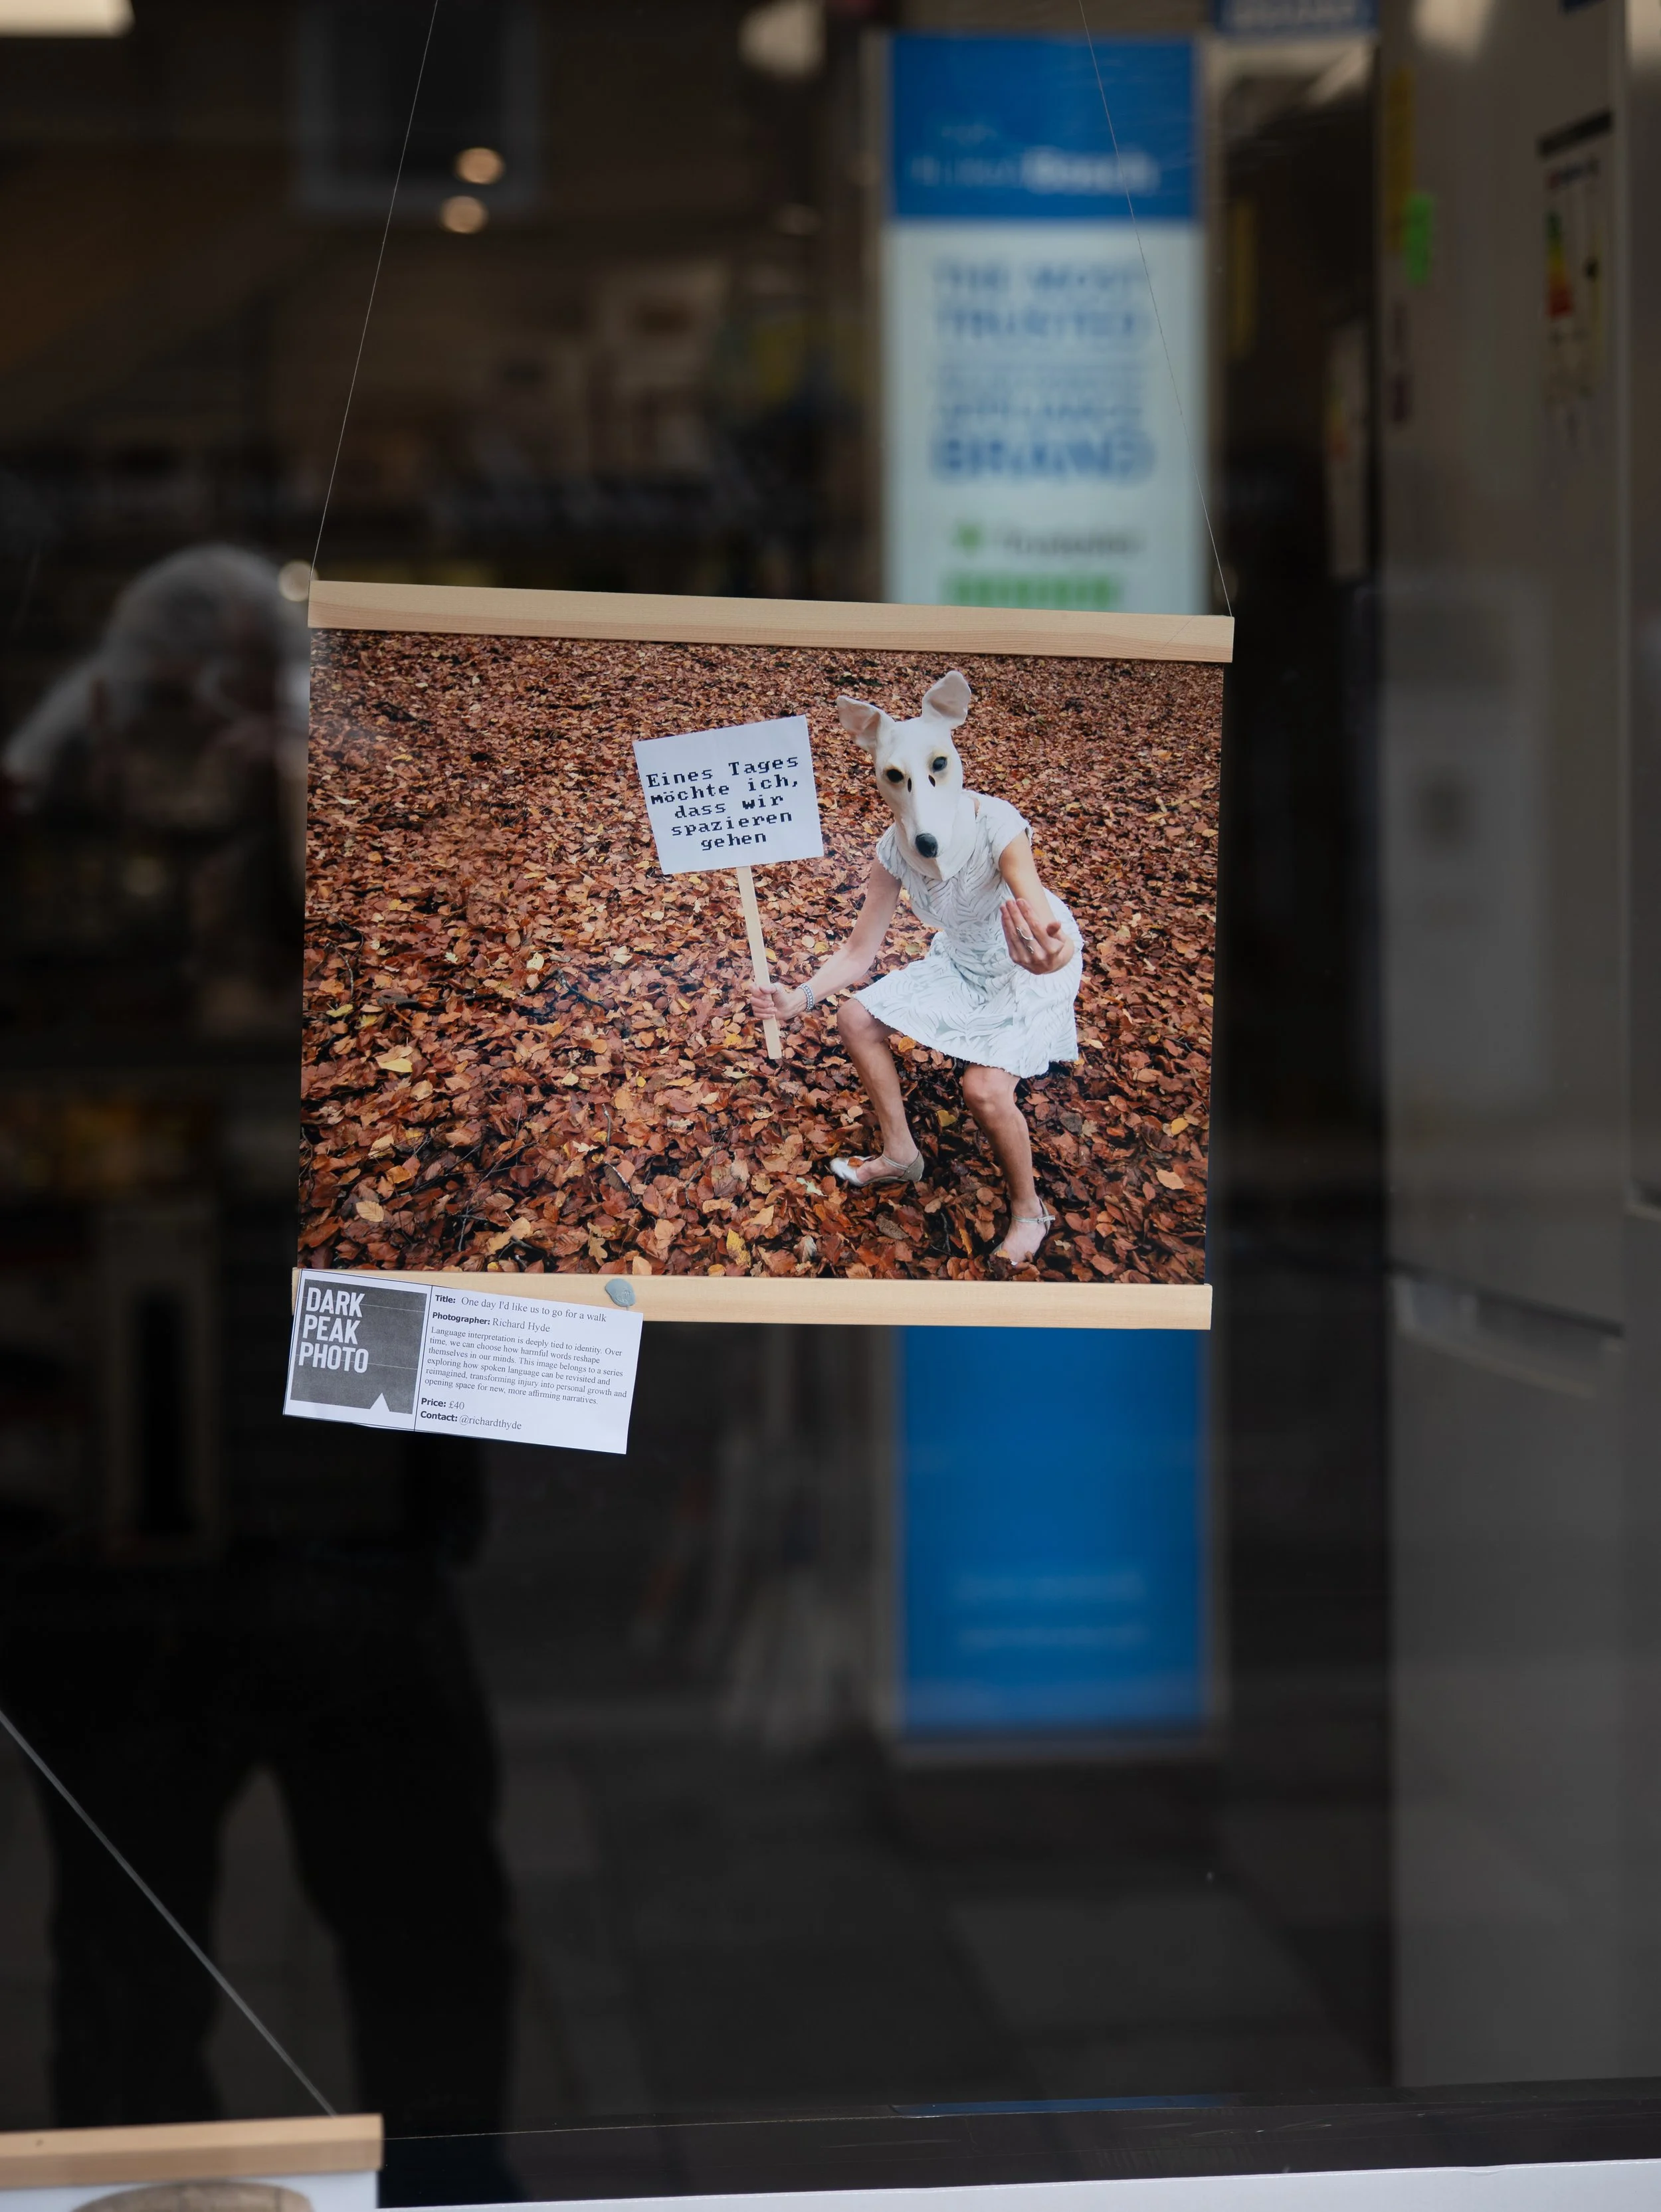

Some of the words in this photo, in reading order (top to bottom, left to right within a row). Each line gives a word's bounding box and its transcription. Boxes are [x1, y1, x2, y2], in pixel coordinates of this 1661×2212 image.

[646, 769, 713, 788] Eines
[728, 757, 799, 776] Tages
[650, 783, 730, 805] möchte
[747, 774, 798, 791] ich,
[674, 803, 726, 818] dass
[742, 794, 783, 810] wir
[671, 812, 792, 836] spazieren
[701, 833, 767, 851] gehen
[306, 1287, 365, 1317] DARK
[435, 1295, 456, 1303] Title:
[461, 1297, 479, 1307] One
[481, 1299, 496, 1310] day
[499, 1301, 510, 1310] I'd
[512, 1302, 528, 1312] like
[551, 1309, 563, 1318] go
[565, 1309, 578, 1318] for
[587, 1313, 607, 1322] walk
[302, 1314, 361, 1344] PEAK
[432, 1312, 490, 1325] Photographer:
[492, 1318, 525, 1329] Richard
[528, 1321, 551, 1333] Hyde
[430, 1336, 448, 1346] time,
[476, 1342, 502, 1352] choose
[504, 1344, 520, 1354] how
[521, 1346, 549, 1358] harmful
[550, 1352, 571, 1360] words
[573, 1354, 601, 1366] reshape
[431, 1326, 466, 1339] Language
[468, 1330, 516, 1344] interpretation
[518, 1336, 524, 1344] is
[526, 1337, 549, 1350] deeply
[551, 1340, 564, 1349] tied
[575, 1342, 602, 1356] identity.
[605, 1346, 623, 1356] Over
[298, 1341, 369, 1373] PHOTO
[427, 1357, 461, 1370] exploring
[463, 1360, 479, 1370] how
[480, 1364, 506, 1373] spoken
[508, 1365, 539, 1379] language
[555, 1371, 565, 1380] be
[565, 1374, 596, 1384] revisited
[597, 1377, 611, 1386] and
[429, 1346, 468, 1358] themselves
[470, 1350, 477, 1359] in
[492, 1354, 517, 1364] minds.
[519, 1356, 535, 1366] This
[536, 1358, 558, 1371] image
[559, 1362, 587, 1374] belongs
[603, 1368, 623, 1377] series
[425, 1378, 453, 1390] opening
[477, 1382, 488, 1392] for
[490, 1386, 506, 1395] new,
[528, 1388, 561, 1402] affirming
[562, 1394, 598, 1404] narratives.
[426, 1366, 468, 1380] reimagined,
[470, 1372, 516, 1386] transforming
[518, 1377, 539, 1390] injury
[541, 1380, 555, 1389] into
[556, 1384, 586, 1393] personal
[587, 1388, 612, 1396] growth
[421, 1398, 446, 1408] Price:
[448, 1400, 465, 1410] £40
[420, 1410, 458, 1422] Contact:
[459, 1414, 522, 1430] @richardthyde
